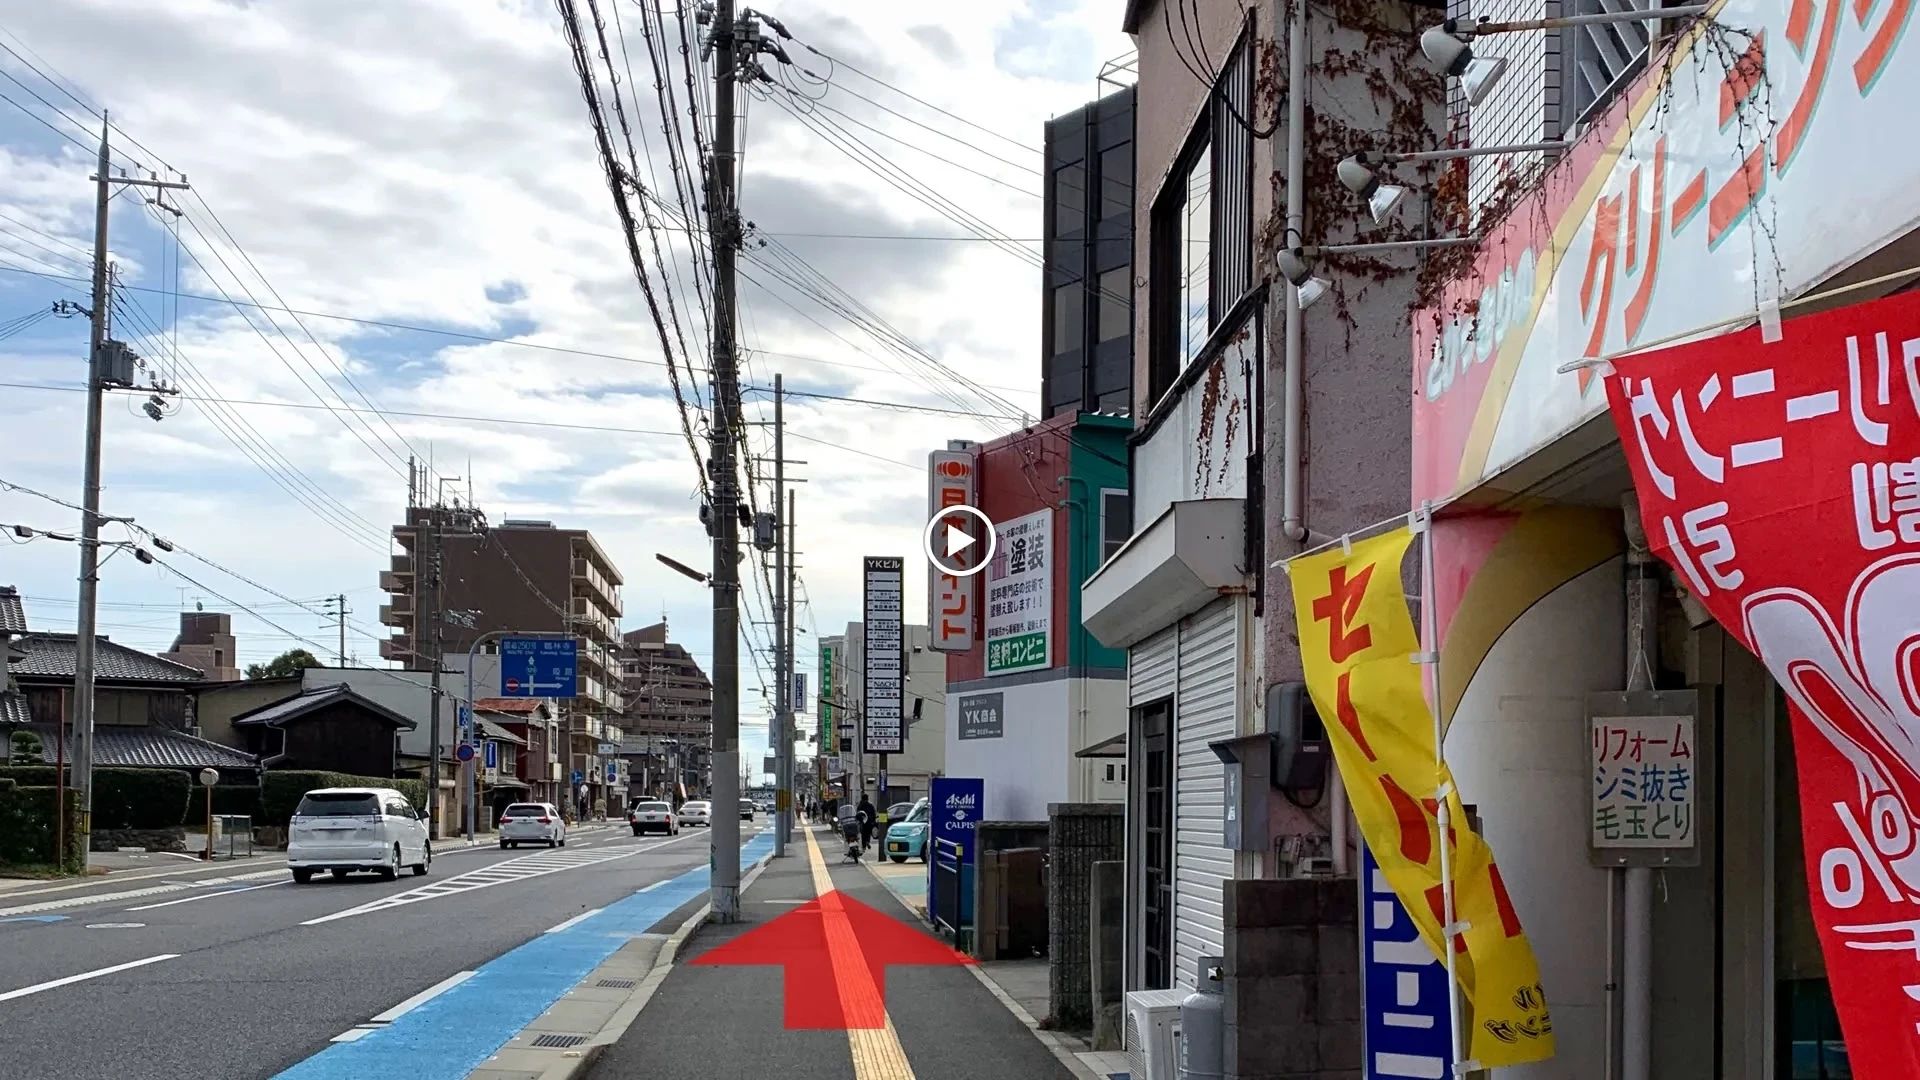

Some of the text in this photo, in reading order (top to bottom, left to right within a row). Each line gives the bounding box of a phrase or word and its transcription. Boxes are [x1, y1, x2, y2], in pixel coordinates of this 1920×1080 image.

[1010, 532, 1044, 575] 塗装
[990, 637, 1044, 668] 塗料コンビニ
[1594, 723, 1691, 763] リフォーム
[945, 793, 975, 805] Asahi
[1595, 763, 1691, 803] シミ抜き
[945, 821, 975, 831] CALPIS
[1595, 803, 1691, 840] 毛玉とり
